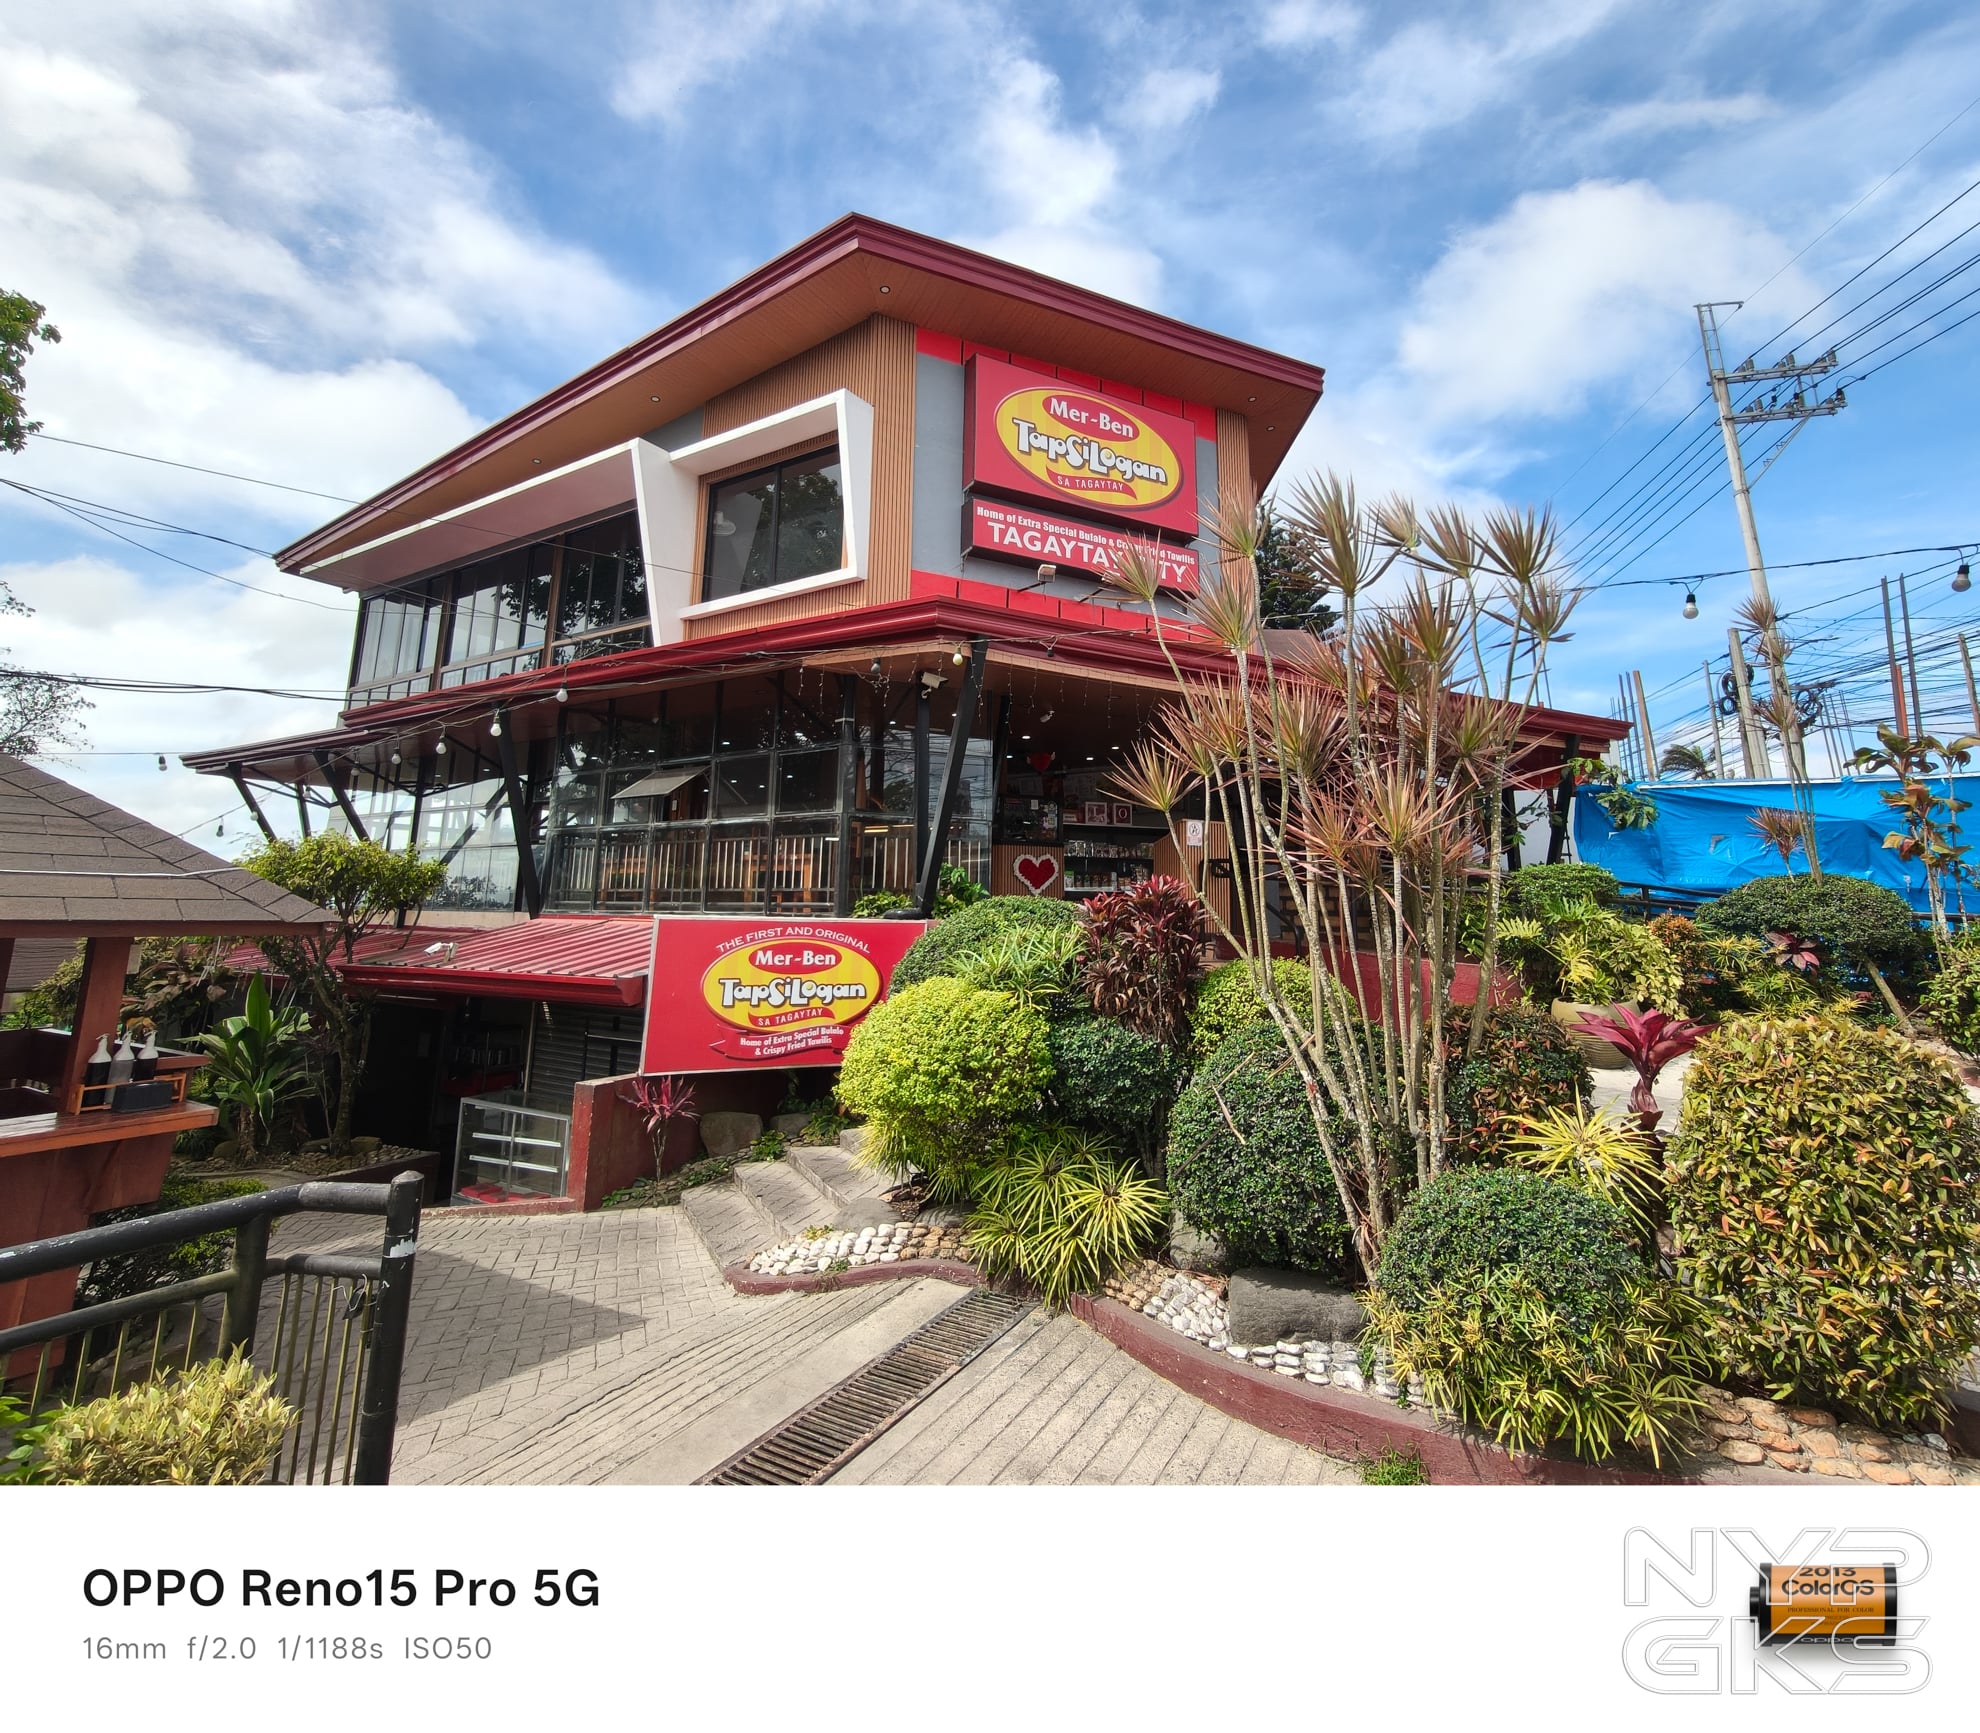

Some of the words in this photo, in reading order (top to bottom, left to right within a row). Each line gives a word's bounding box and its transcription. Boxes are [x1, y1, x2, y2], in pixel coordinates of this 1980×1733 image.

[1012, 418, 1167, 484] TapSiLogan
[1057, 475, 1071, 488] SA
[1075, 479, 1124, 491] TAGAYTAY
[977, 506, 1004, 521] Home
[1007, 514, 1015, 523] of
[1018, 516, 1040, 529] Extra
[1043, 521, 1077, 538] Special
[1079, 530, 1107, 545] Bulalo
[1108, 538, 1115, 546] &
[1167, 551, 1195, 565] Tawilis
[716, 936, 745, 953] THE
[746, 927, 783, 942] FIRST
[786, 927, 813, 936] AND
[815, 928, 870, 954] ORIGINAL
[754, 950, 836, 966] Mer-Ben
[719, 977, 867, 1007] TapSiLogan
[758, 1017, 771, 1026] SA
[775, 1008, 823, 1024] TAGAYTAY
[740, 1037, 762, 1047] Home
[763, 1038, 772, 1046] of
[774, 1036, 792, 1045] Extra
[794, 1028, 820, 1041] Special
[821, 1026, 844, 1036] Bulalo
[754, 1047, 762, 1056] &
[763, 1046, 786, 1056] Crispy
[787, 1040, 806, 1051] Fried
[808, 1036, 832, 1045] Tawilis
